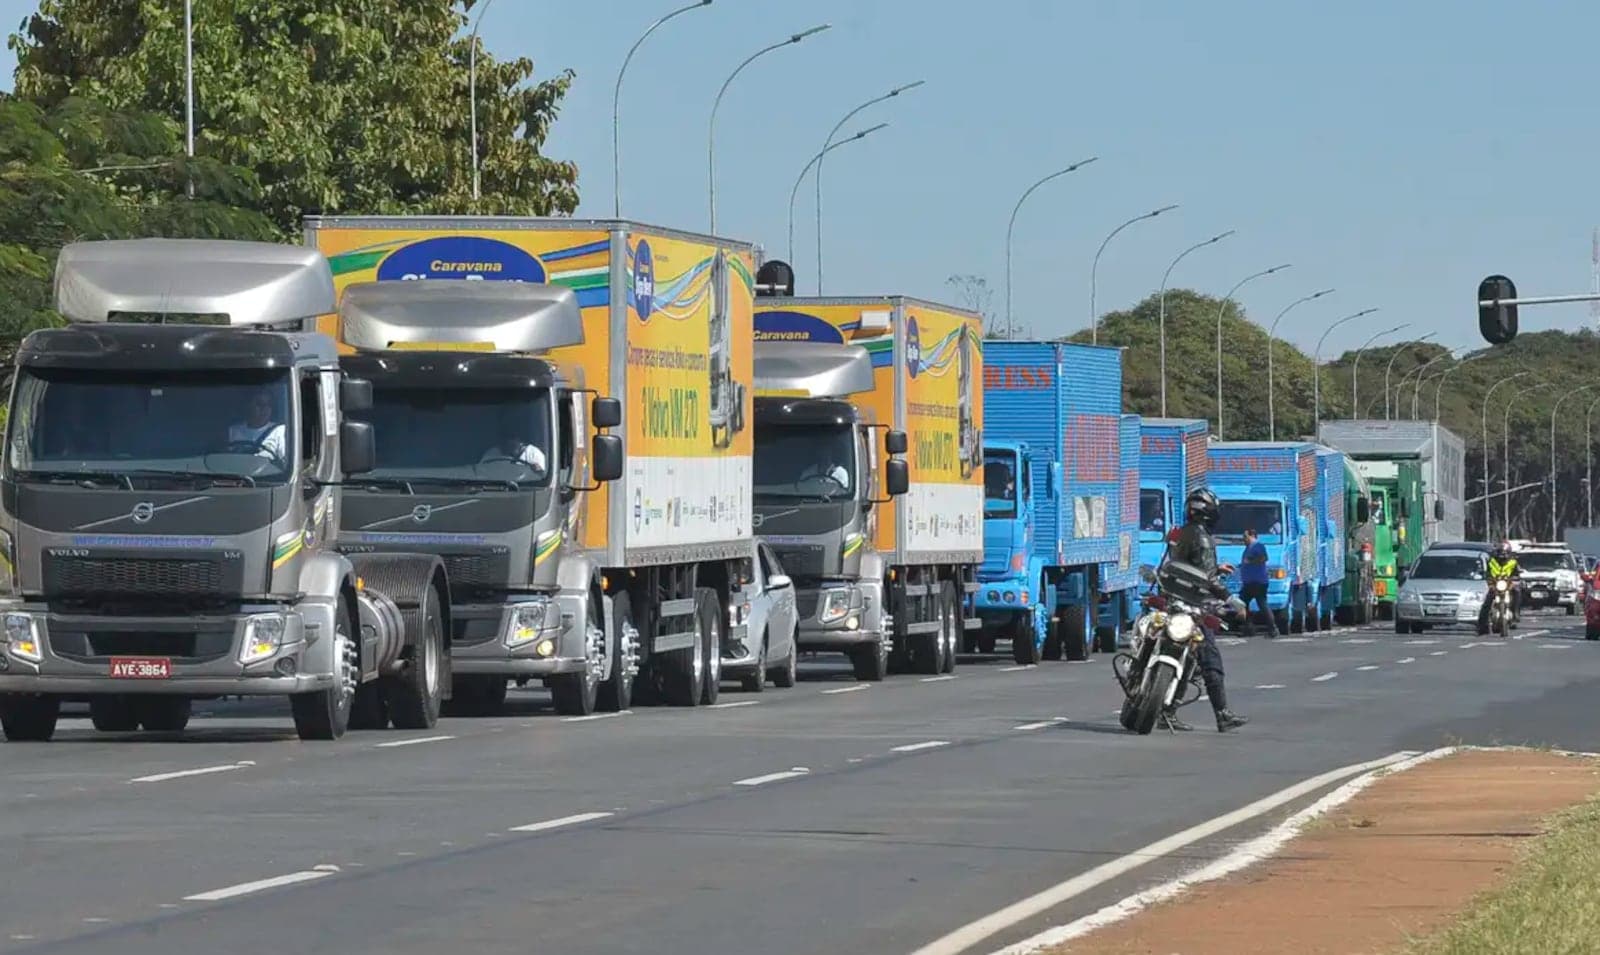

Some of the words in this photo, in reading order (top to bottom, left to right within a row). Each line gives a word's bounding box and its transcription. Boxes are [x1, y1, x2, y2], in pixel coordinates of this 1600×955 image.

[430, 259, 502, 272] Caravana
[753, 330, 810, 341] Caravana
[48, 549, 89, 557] VOLVO
[224, 551, 240, 559] VM
